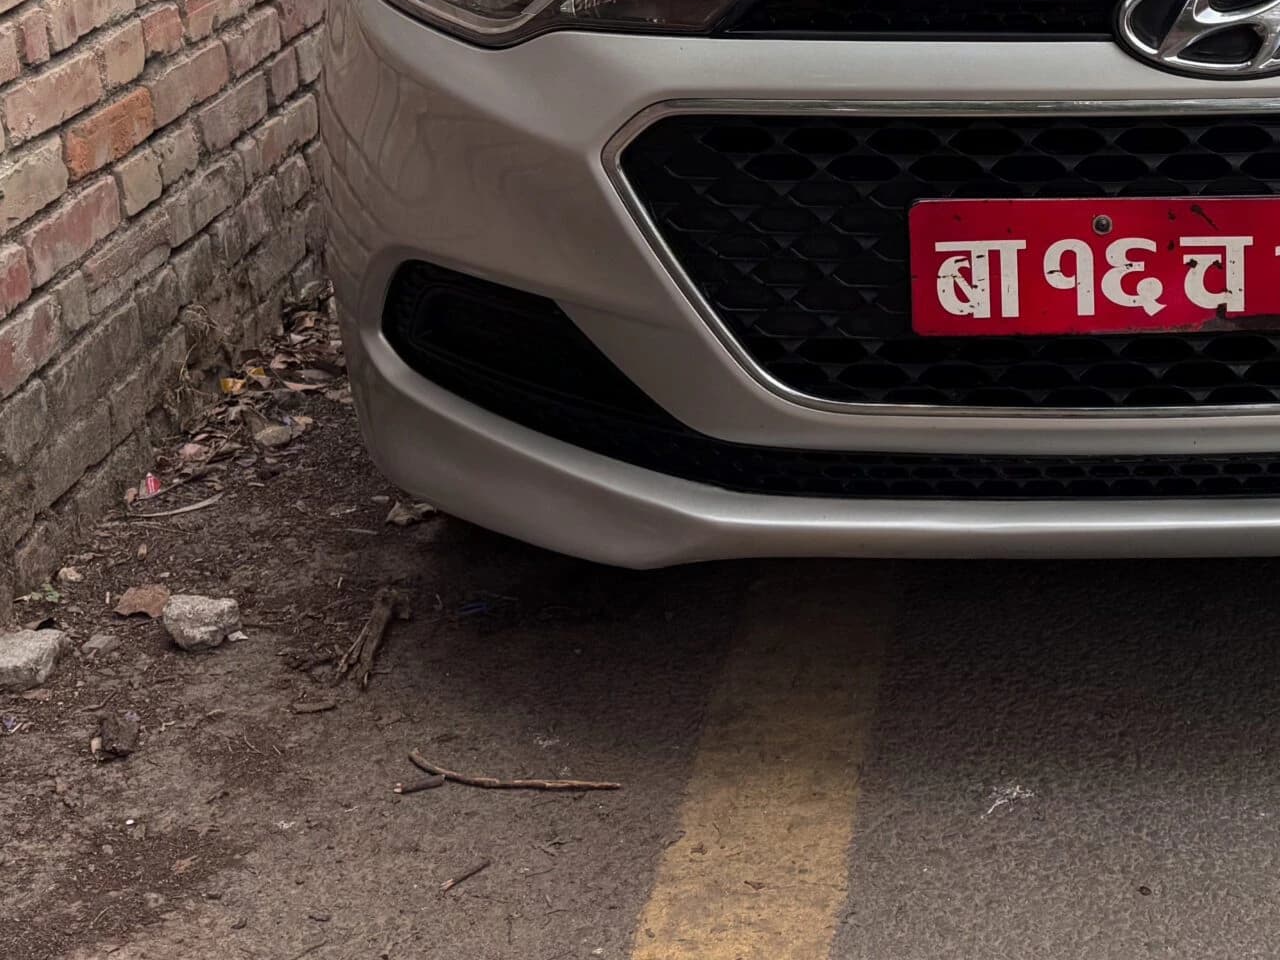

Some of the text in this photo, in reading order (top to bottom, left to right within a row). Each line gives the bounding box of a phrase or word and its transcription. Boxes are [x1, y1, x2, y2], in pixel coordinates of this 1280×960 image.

[935, 239, 1026, 318] बा
[1044, 238, 1166, 316] १६
[1180, 235, 1254, 312] च
